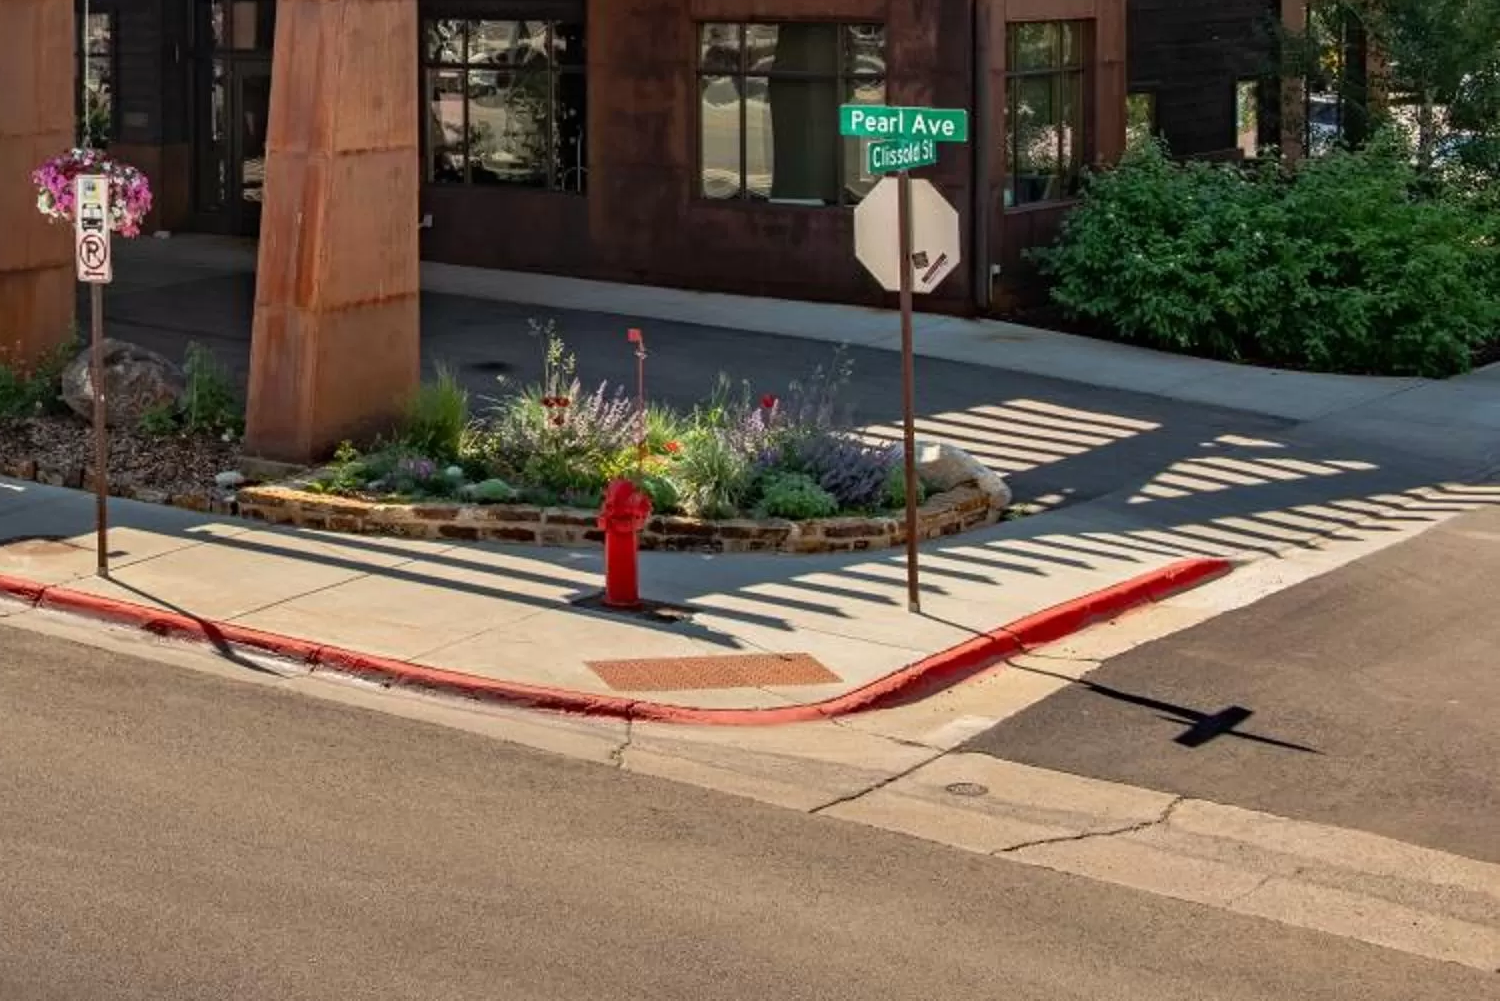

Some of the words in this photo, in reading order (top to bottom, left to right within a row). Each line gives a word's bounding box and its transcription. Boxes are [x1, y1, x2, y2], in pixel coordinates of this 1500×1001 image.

[851, 109, 903, 134] Pearl
[911, 114, 955, 136] Ave
[872, 142, 921, 167] Clissold
[921, 139, 933, 160] St
